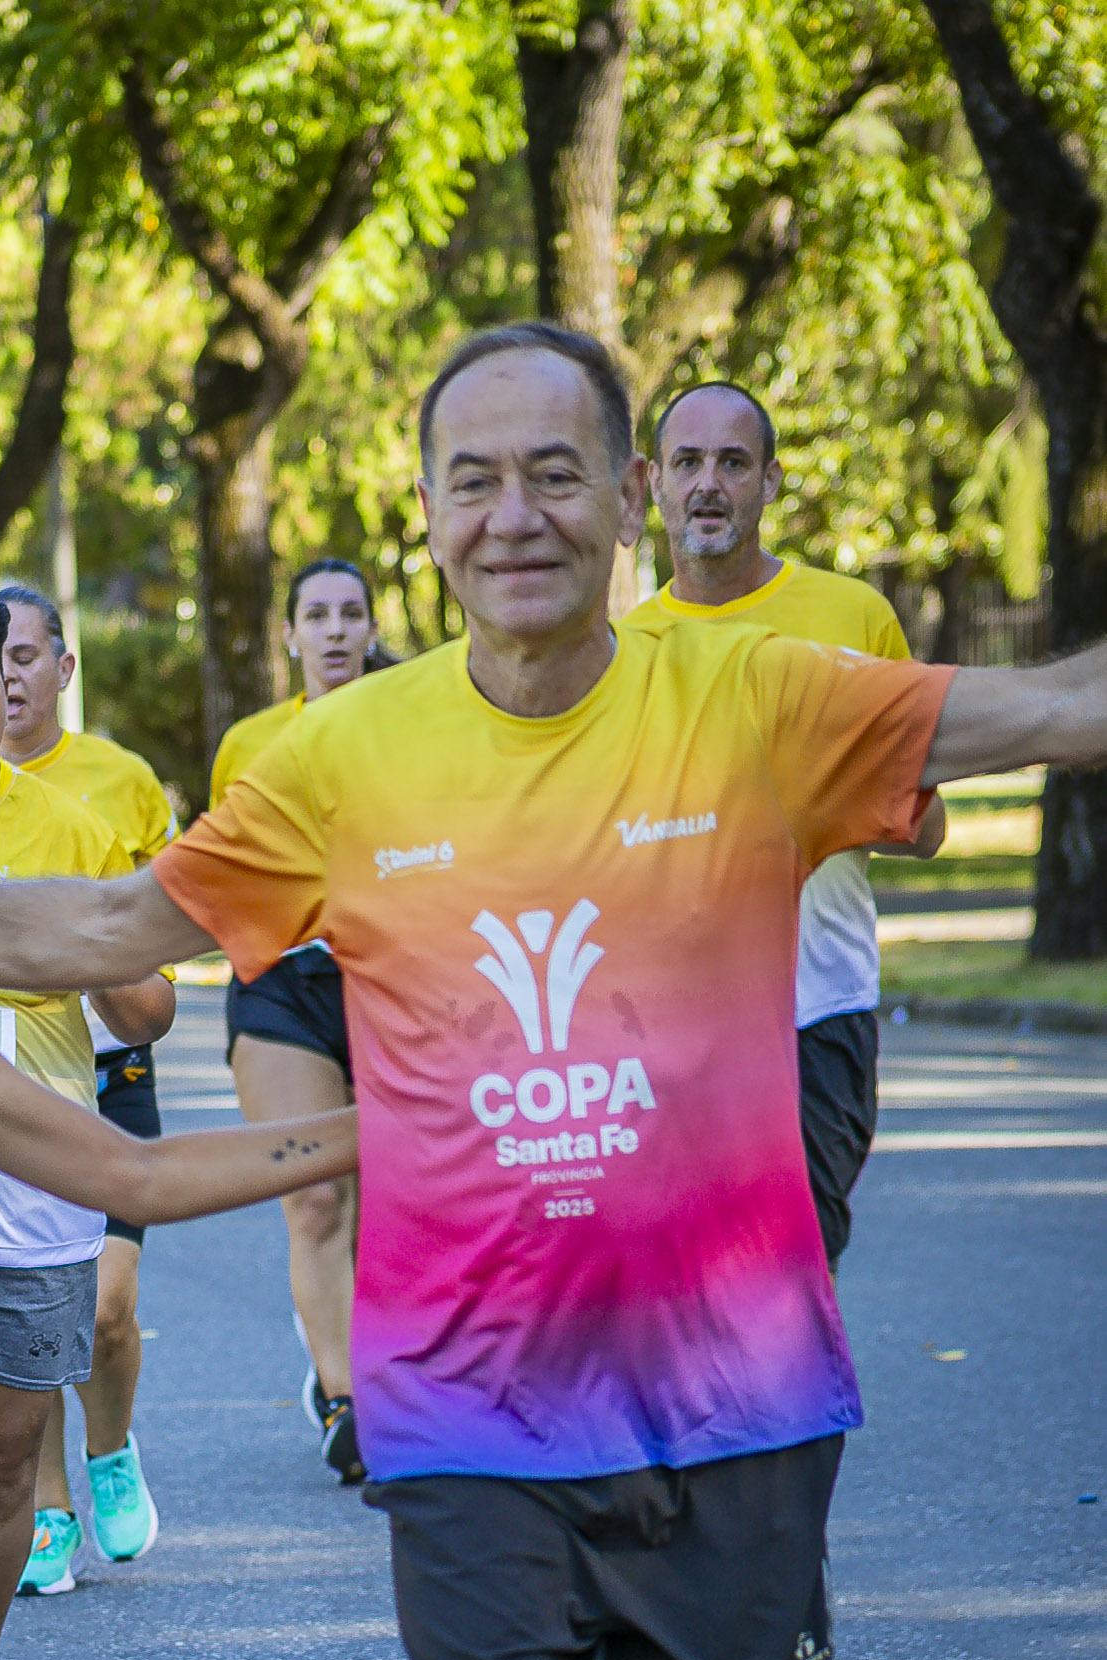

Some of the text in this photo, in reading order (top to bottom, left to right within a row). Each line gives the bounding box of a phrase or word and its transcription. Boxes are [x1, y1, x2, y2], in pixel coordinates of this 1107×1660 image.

[438, 839, 455, 862] 6
[469, 1057, 657, 1128] COPA
[496, 1123, 639, 1167] Santa Fe
[544, 1197, 595, 1219] 2025
